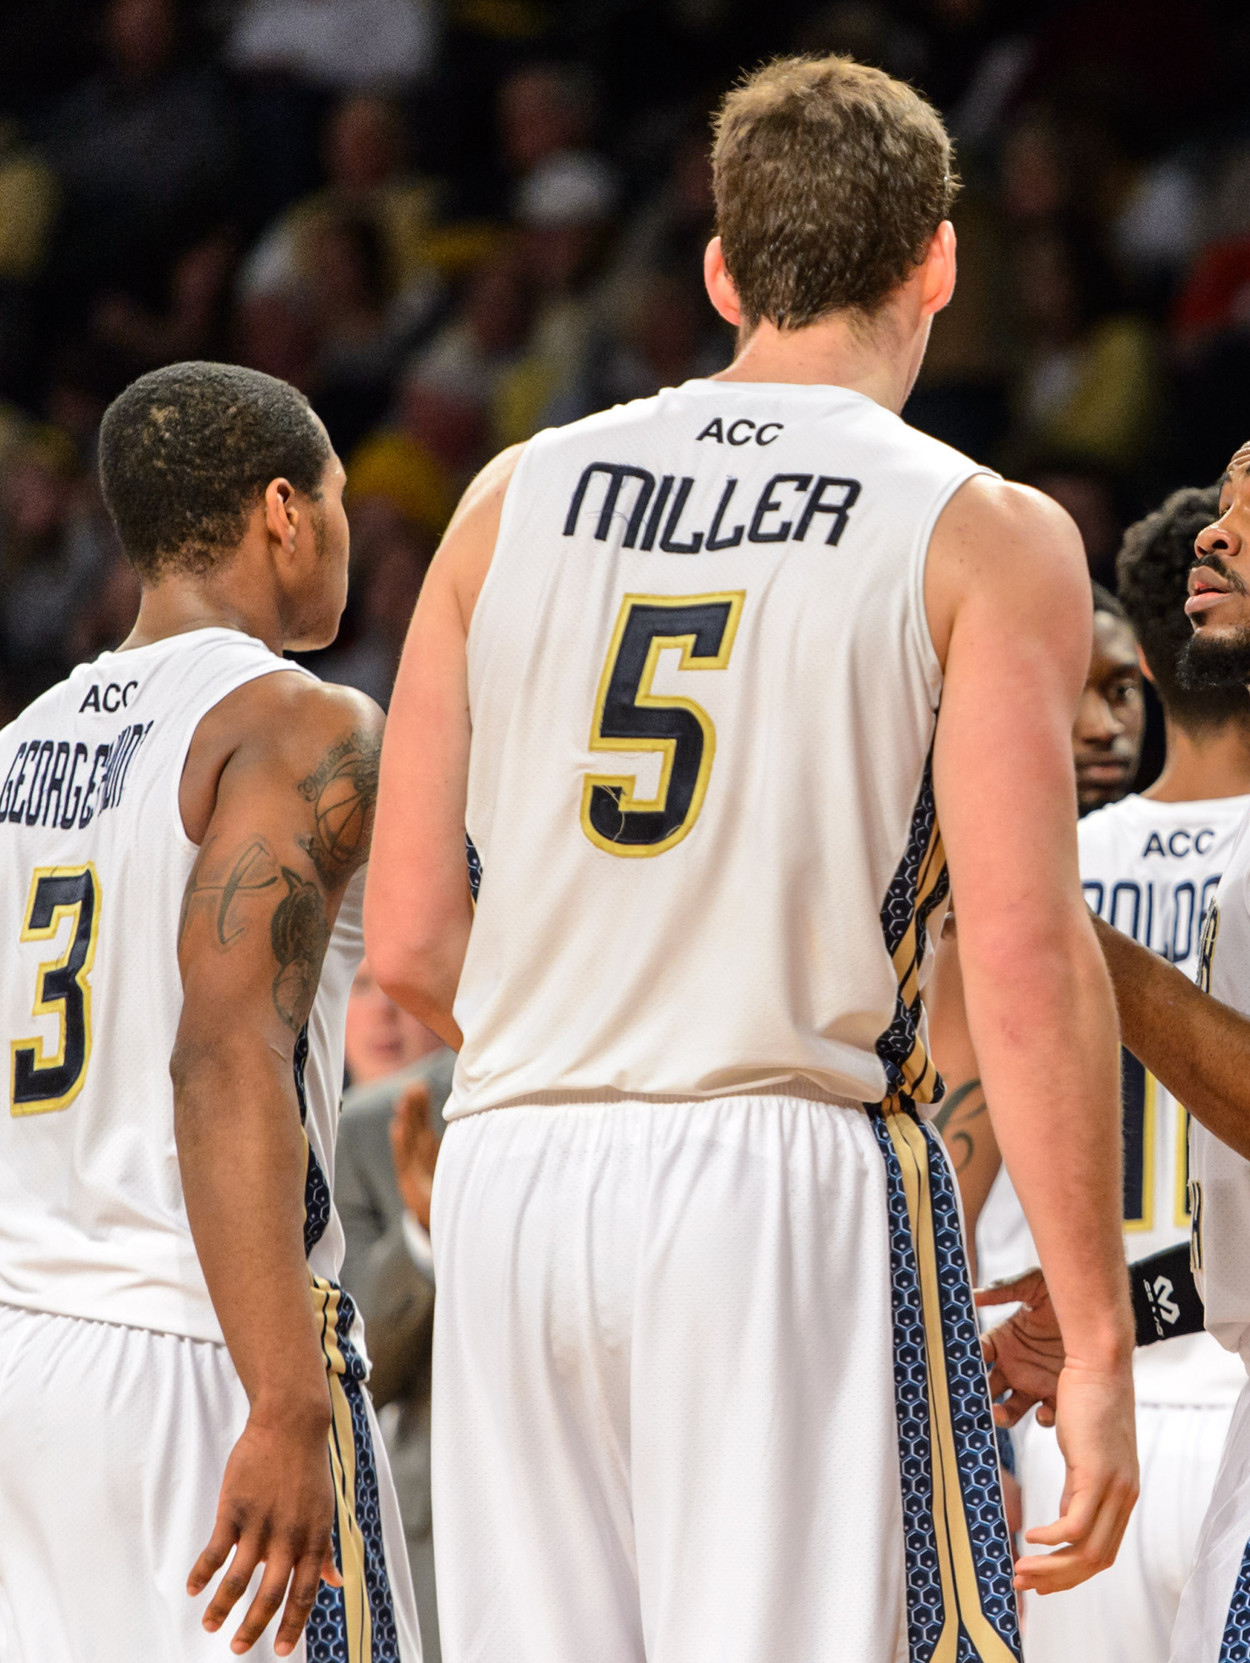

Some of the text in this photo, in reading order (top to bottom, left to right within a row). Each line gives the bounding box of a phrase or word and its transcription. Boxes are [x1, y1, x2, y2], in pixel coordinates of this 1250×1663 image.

[695, 416, 784, 447] ACC
[563, 460, 862, 555] MILLER
[78, 680, 139, 714] ACC
[579, 588, 747, 859] 5
[1142, 829, 1216, 859] ACC
[9, 859, 103, 1118] 3
